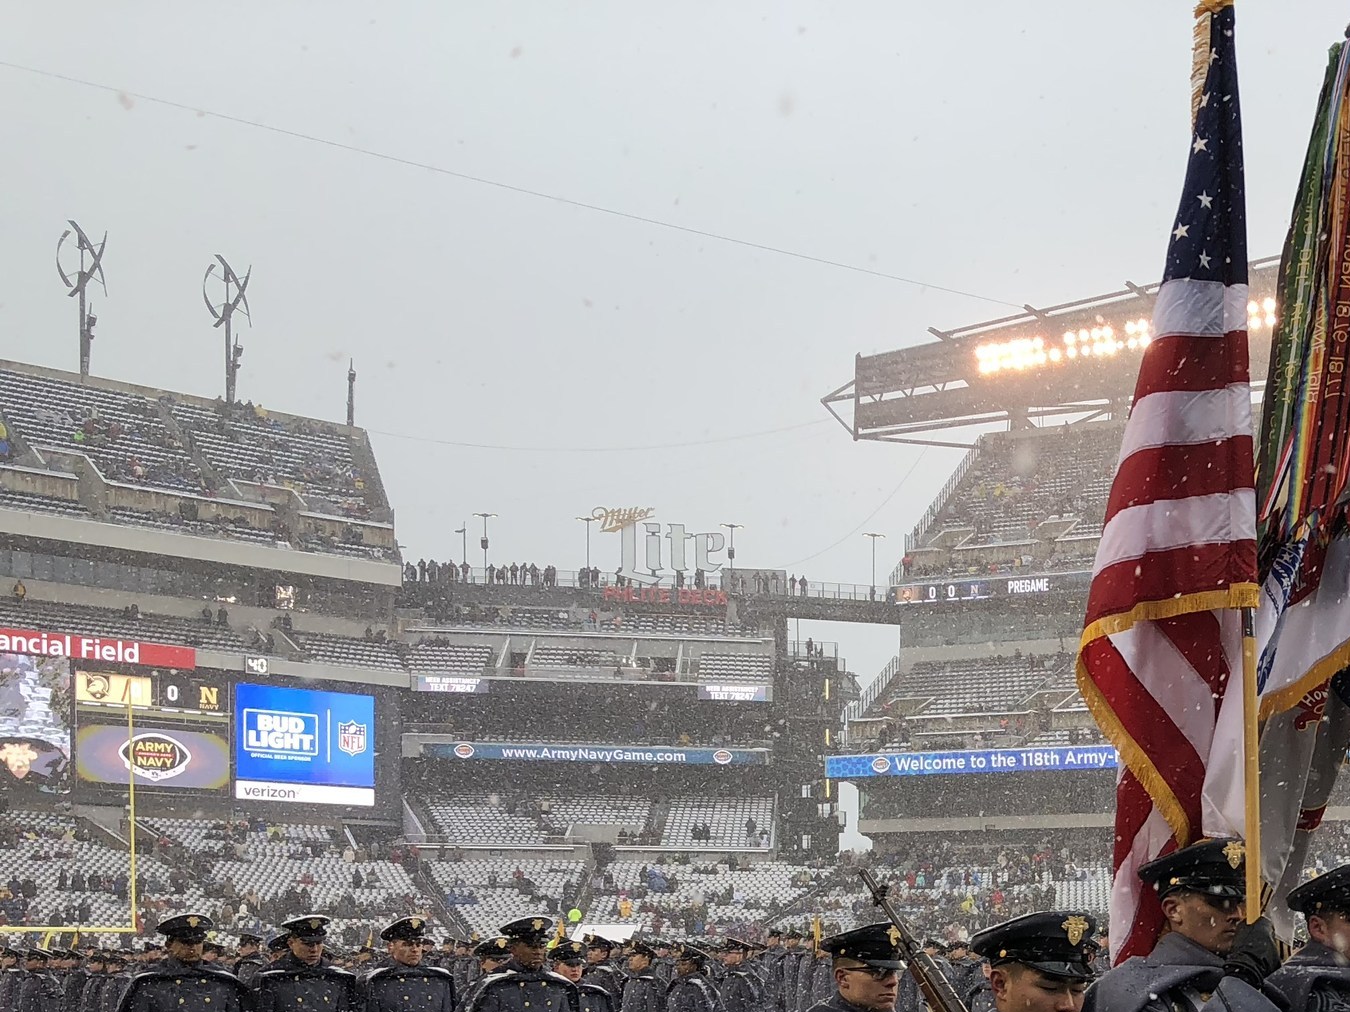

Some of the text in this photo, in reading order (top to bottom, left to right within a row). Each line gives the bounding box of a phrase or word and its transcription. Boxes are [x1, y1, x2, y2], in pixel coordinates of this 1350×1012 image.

[592, 506, 655, 532] Miller
[616, 521, 725, 585] Lite
[929, 587, 936, 598] 0
[948, 585, 956, 597] 0
[1007, 579, 1050, 594] PREGAME
[0, 633, 139, 663] ancial Field
[248, 658, 268, 673] 40
[167, 685, 218, 705] 0 N
[257, 714, 305, 734] BUD
[136, 742, 174, 753] ARMY
[343, 736, 363, 750] NFL
[138, 757, 173, 767] NAVY
[502, 748, 686, 762] www.ArmyNavyGame.com
[895, 756, 966, 772] Welcome
[970, 757, 983, 769] to
[988, 753, 1016, 768] the
[1021, 752, 1060, 766] 118th
[244, 786, 296, 799] verizon
